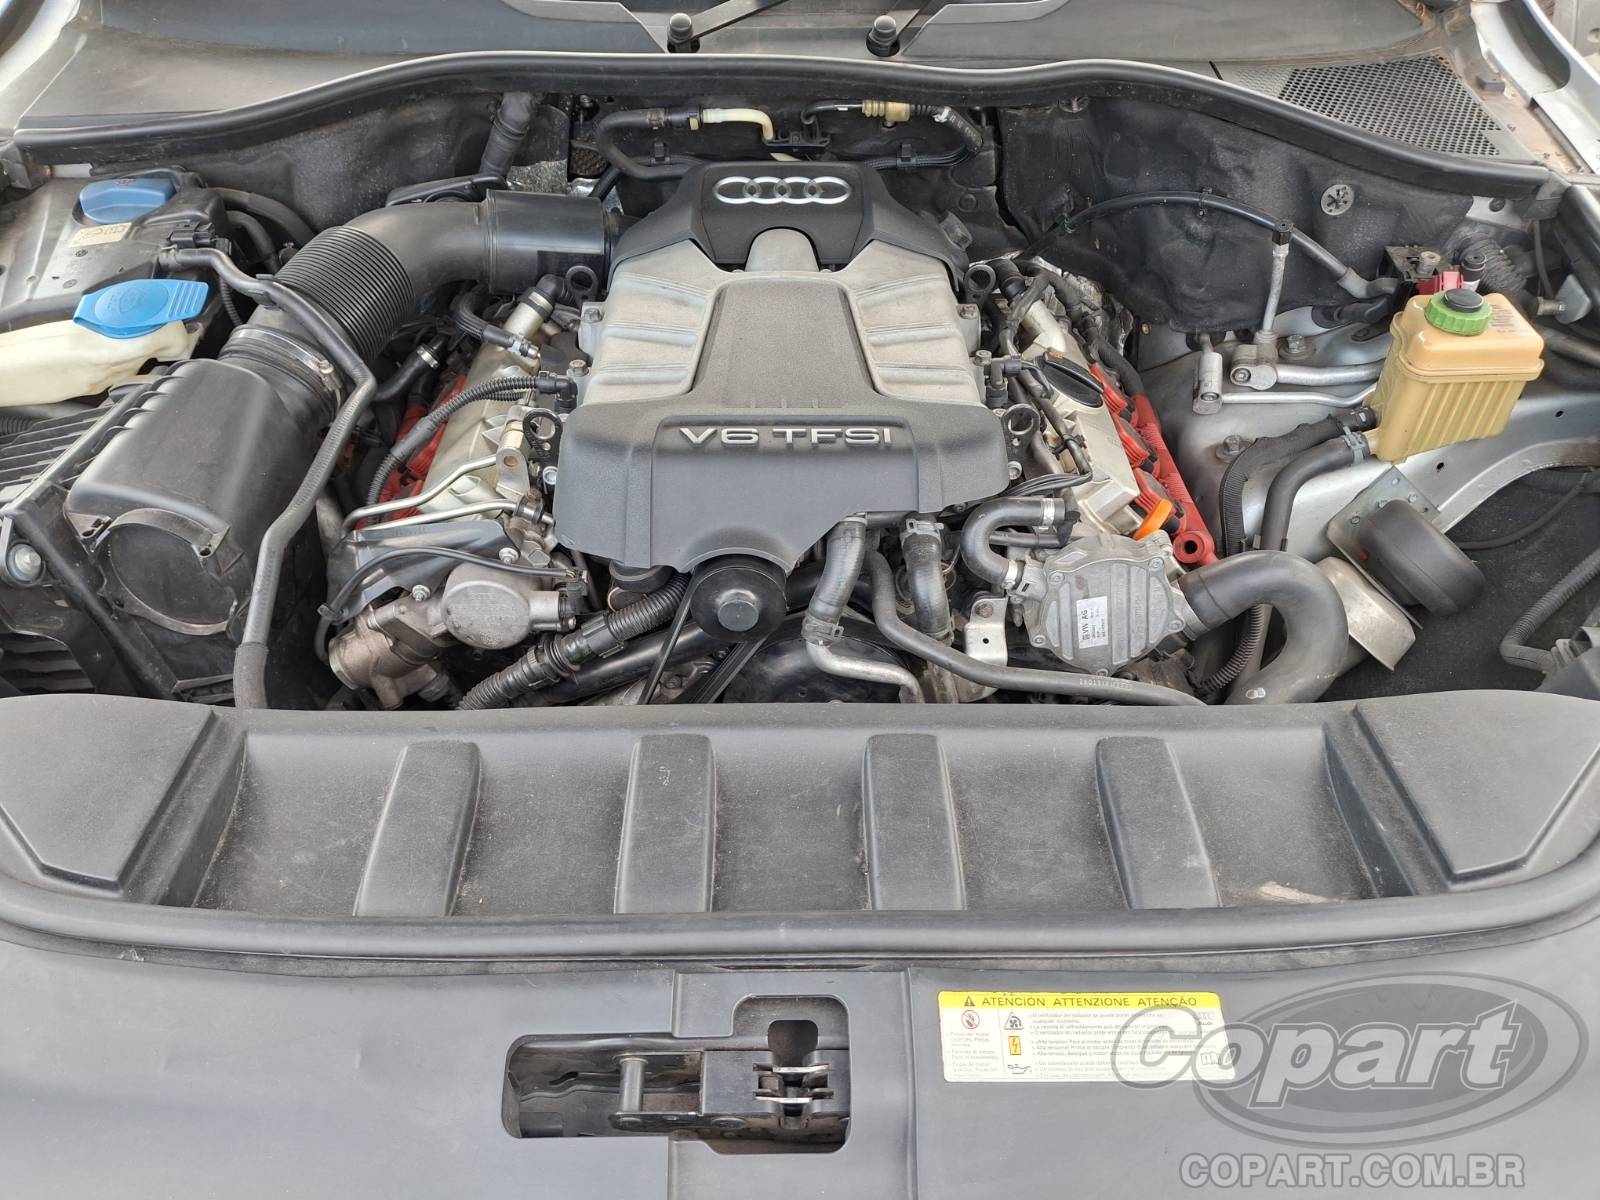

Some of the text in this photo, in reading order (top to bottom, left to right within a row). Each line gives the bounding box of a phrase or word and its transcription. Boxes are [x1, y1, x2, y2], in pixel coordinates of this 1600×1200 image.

[679, 427, 893, 446] V6 TFSI
[1053, 997, 1130, 1007] ATTENZIONE
[1137, 996, 1197, 1008] ATENÇÃO
